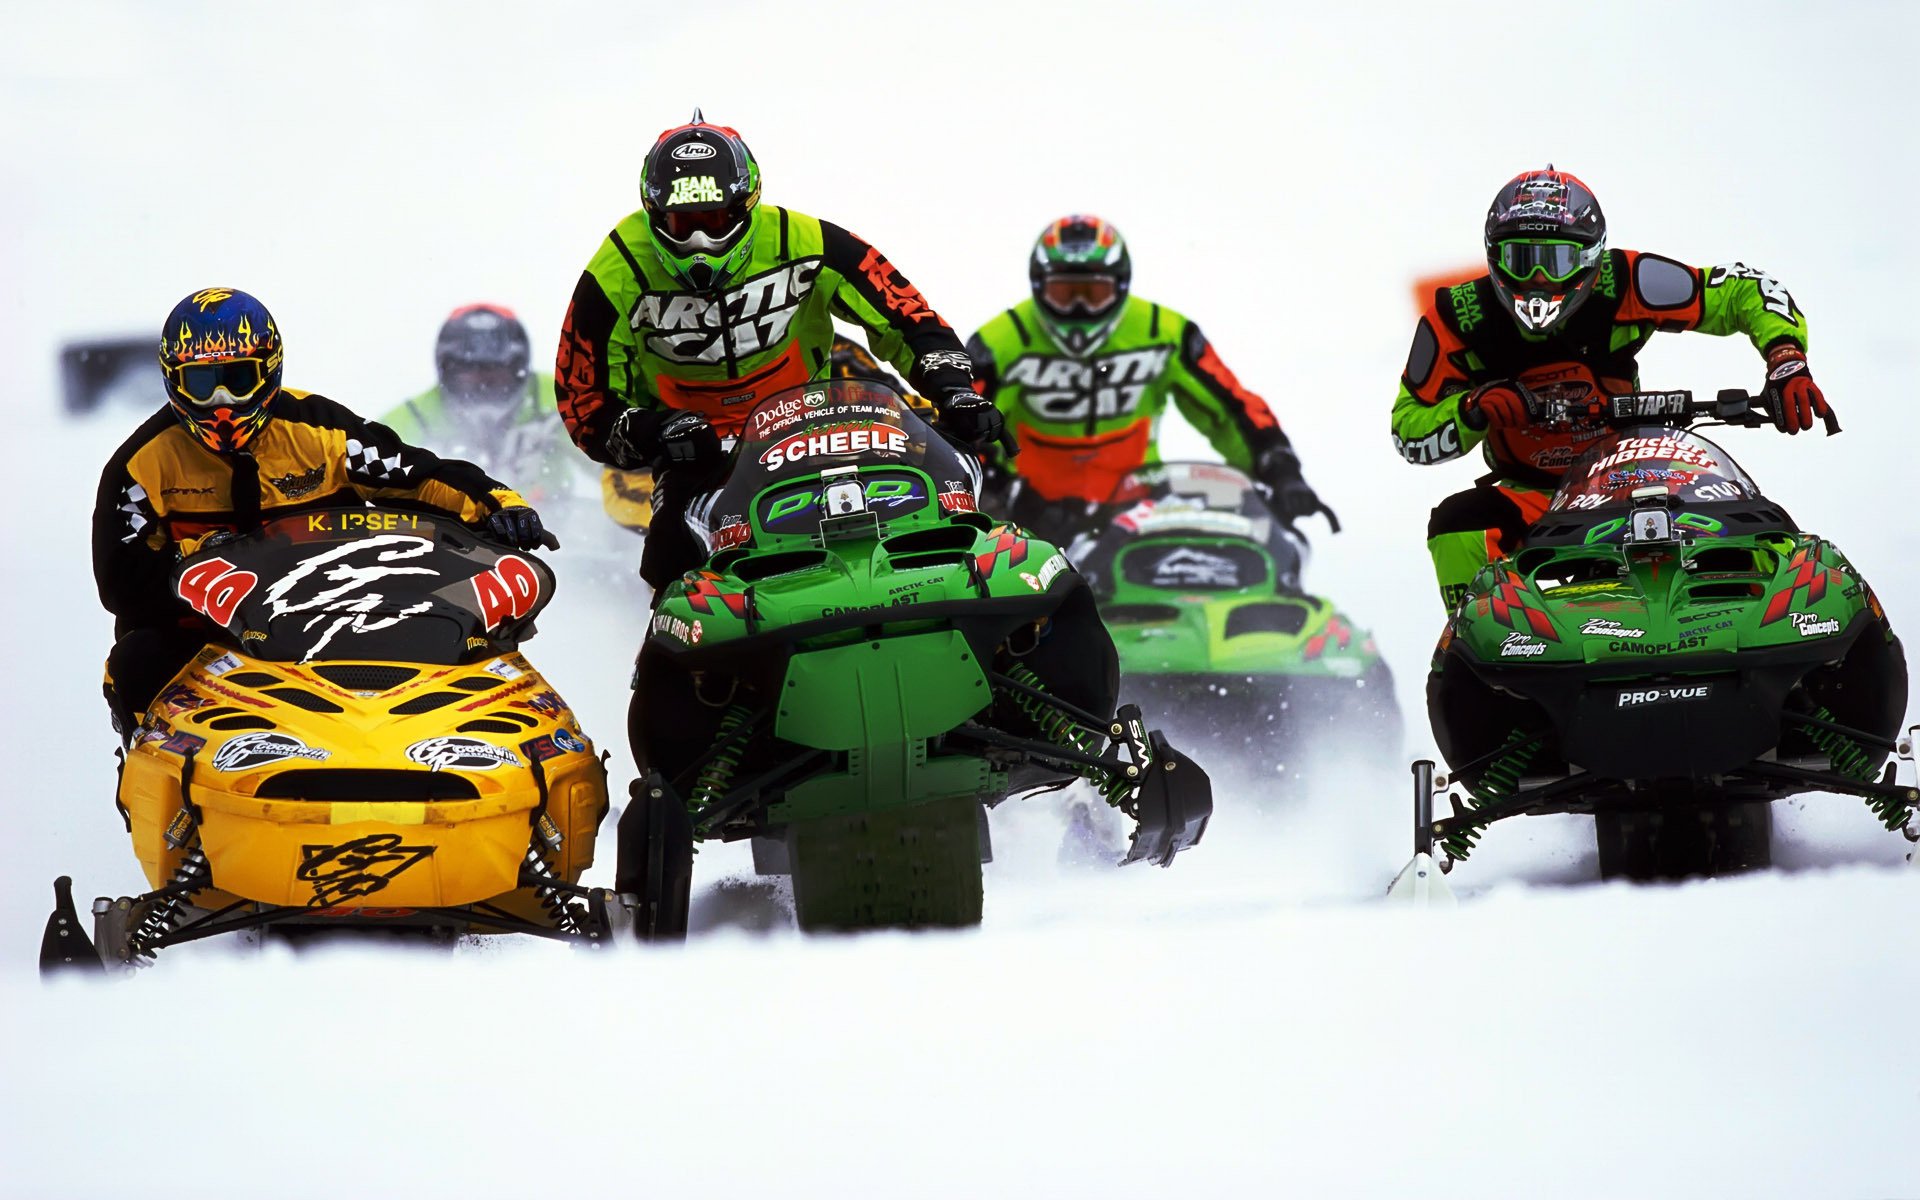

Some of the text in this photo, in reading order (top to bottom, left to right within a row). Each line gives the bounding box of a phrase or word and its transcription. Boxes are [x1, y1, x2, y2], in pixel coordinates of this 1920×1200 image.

[679, 144, 711, 156] Arai
[672, 176, 716, 192] TEAM
[666, 189, 723, 206] ARCTIC
[1519, 223, 1559, 232] SCOTT
[631, 260, 821, 330] ARCTIC
[1463, 281, 1485, 324] TEAM
[647, 305, 800, 364] CAT
[194, 351, 236, 360] SCOTT
[754, 399, 802, 430] Dodge
[1637, 394, 1685, 416] TAPER
[758, 405, 901, 439] THE OFFICIAL VEHICLE OF TEAM ARCTIC
[765, 430, 907, 472] SCHEELE
[1616, 435, 1707, 456] Tucker
[1587, 446, 1718, 479] HIBBERT
[1694, 481, 1742, 502] STUD
[1567, 493, 1613, 510] BOY
[308, 514, 333, 532] K.
[178, 557, 259, 628] 40
[470, 554, 540, 633] 40
[888, 576, 945, 596] ARCTIC CAT
[1677, 607, 1745, 624] SCOTT
[1789, 612, 1818, 628] Pro
[670, 617, 690, 645] BROS.
[1581, 625, 1646, 638] Concepts
[1679, 620, 1734, 640] ARCTIC CAT
[1800, 618, 1840, 637] Concepts
[466, 636, 489, 651] Moose
[1500, 631, 1532, 646] Pro
[1609, 636, 1709, 655] CAMOPLAST
[1501, 641, 1547, 659] Concepts
[1618, 686, 1708, 707] PRO-VUE
[453, 745, 519, 762] Goodwin
